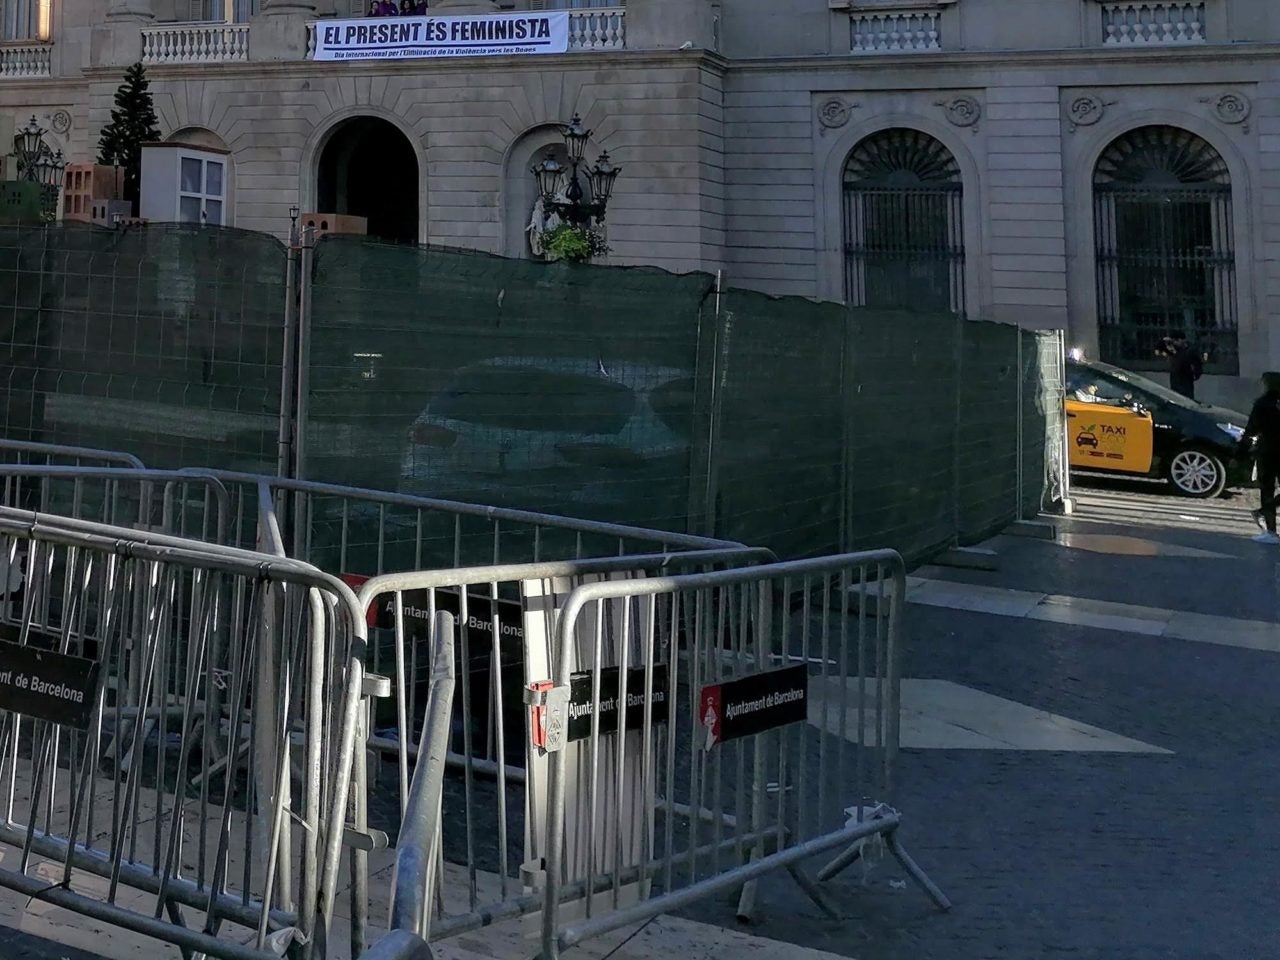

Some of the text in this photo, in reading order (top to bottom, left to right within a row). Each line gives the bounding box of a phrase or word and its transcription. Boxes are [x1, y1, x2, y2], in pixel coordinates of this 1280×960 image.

[323, 18, 551, 45] EL PRESENT ÉS FEMINISTA
[1100, 424, 1126, 436] TAXI
[469, 616, 523, 637] Barclona
[15, 672, 28, 689] de
[31, 676, 84, 704] Barcelona
[725, 688, 804, 721] Ajuntament de Barcelona
